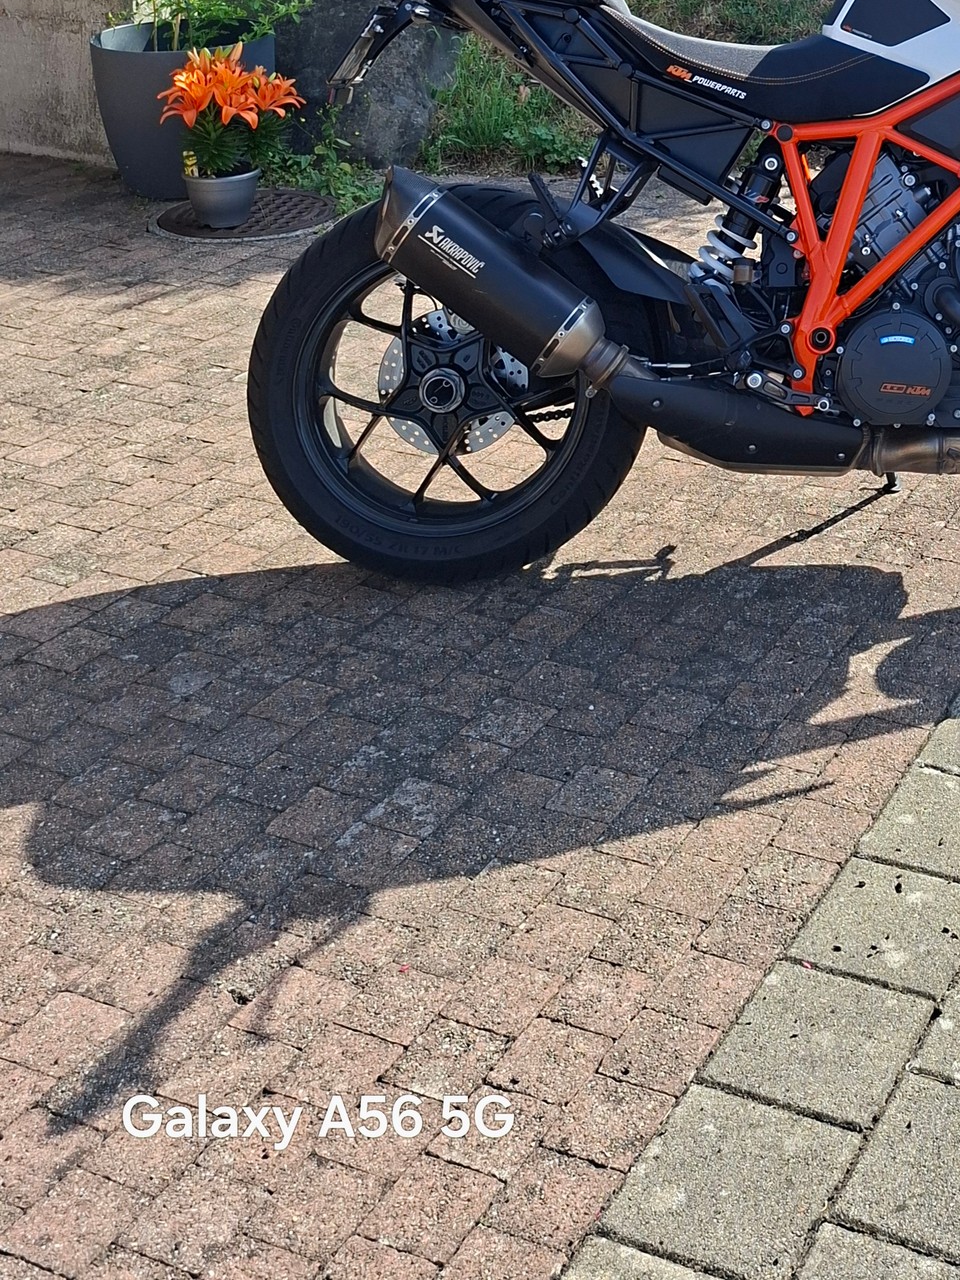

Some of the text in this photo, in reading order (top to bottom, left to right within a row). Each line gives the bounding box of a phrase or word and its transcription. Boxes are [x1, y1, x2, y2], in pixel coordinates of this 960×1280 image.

[666, 65, 747, 100] KTM POWERPARTS
[906, 385, 931, 396] KTM
